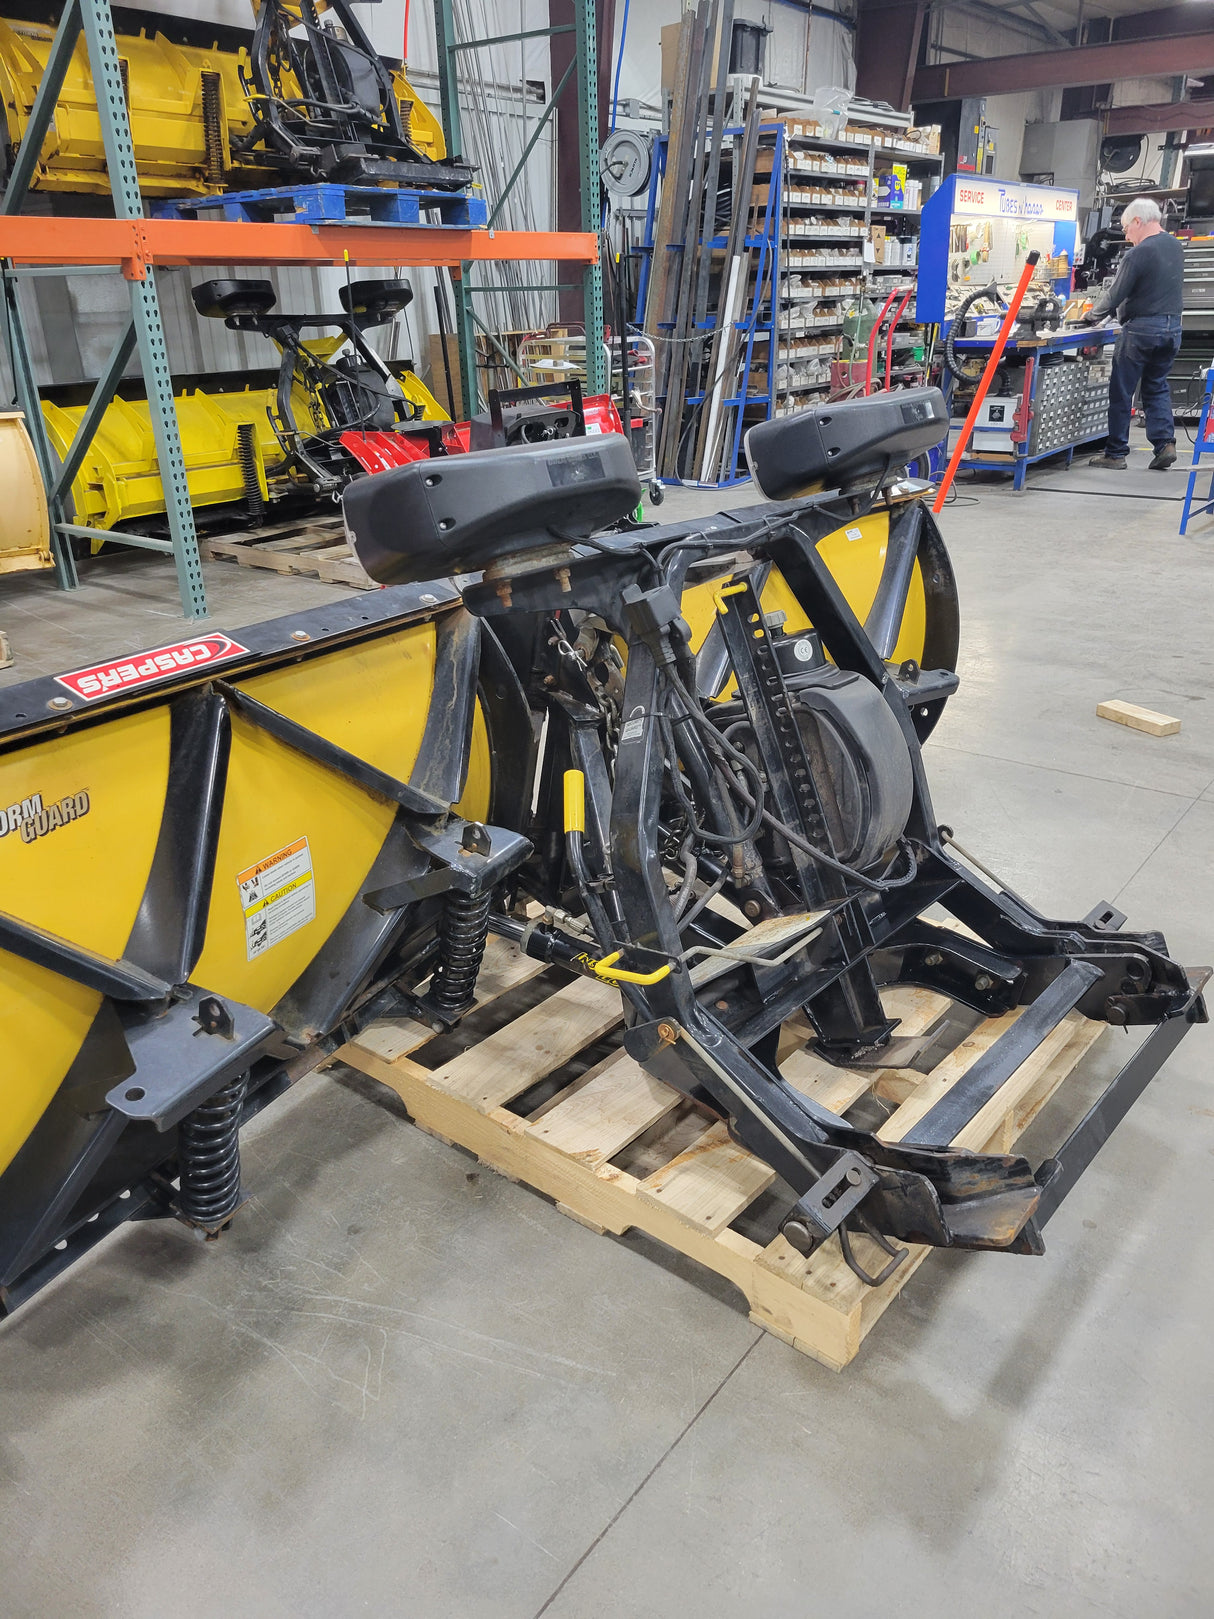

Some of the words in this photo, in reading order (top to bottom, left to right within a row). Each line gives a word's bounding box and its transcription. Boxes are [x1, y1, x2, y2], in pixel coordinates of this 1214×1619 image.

[960, 190, 984, 204] SERVICE
[1056, 200, 1073, 212] CENTER
[20, 791, 90, 843] GUARD
[262, 849, 293, 870] WARNING
[270, 883, 297, 902] CAUTION
